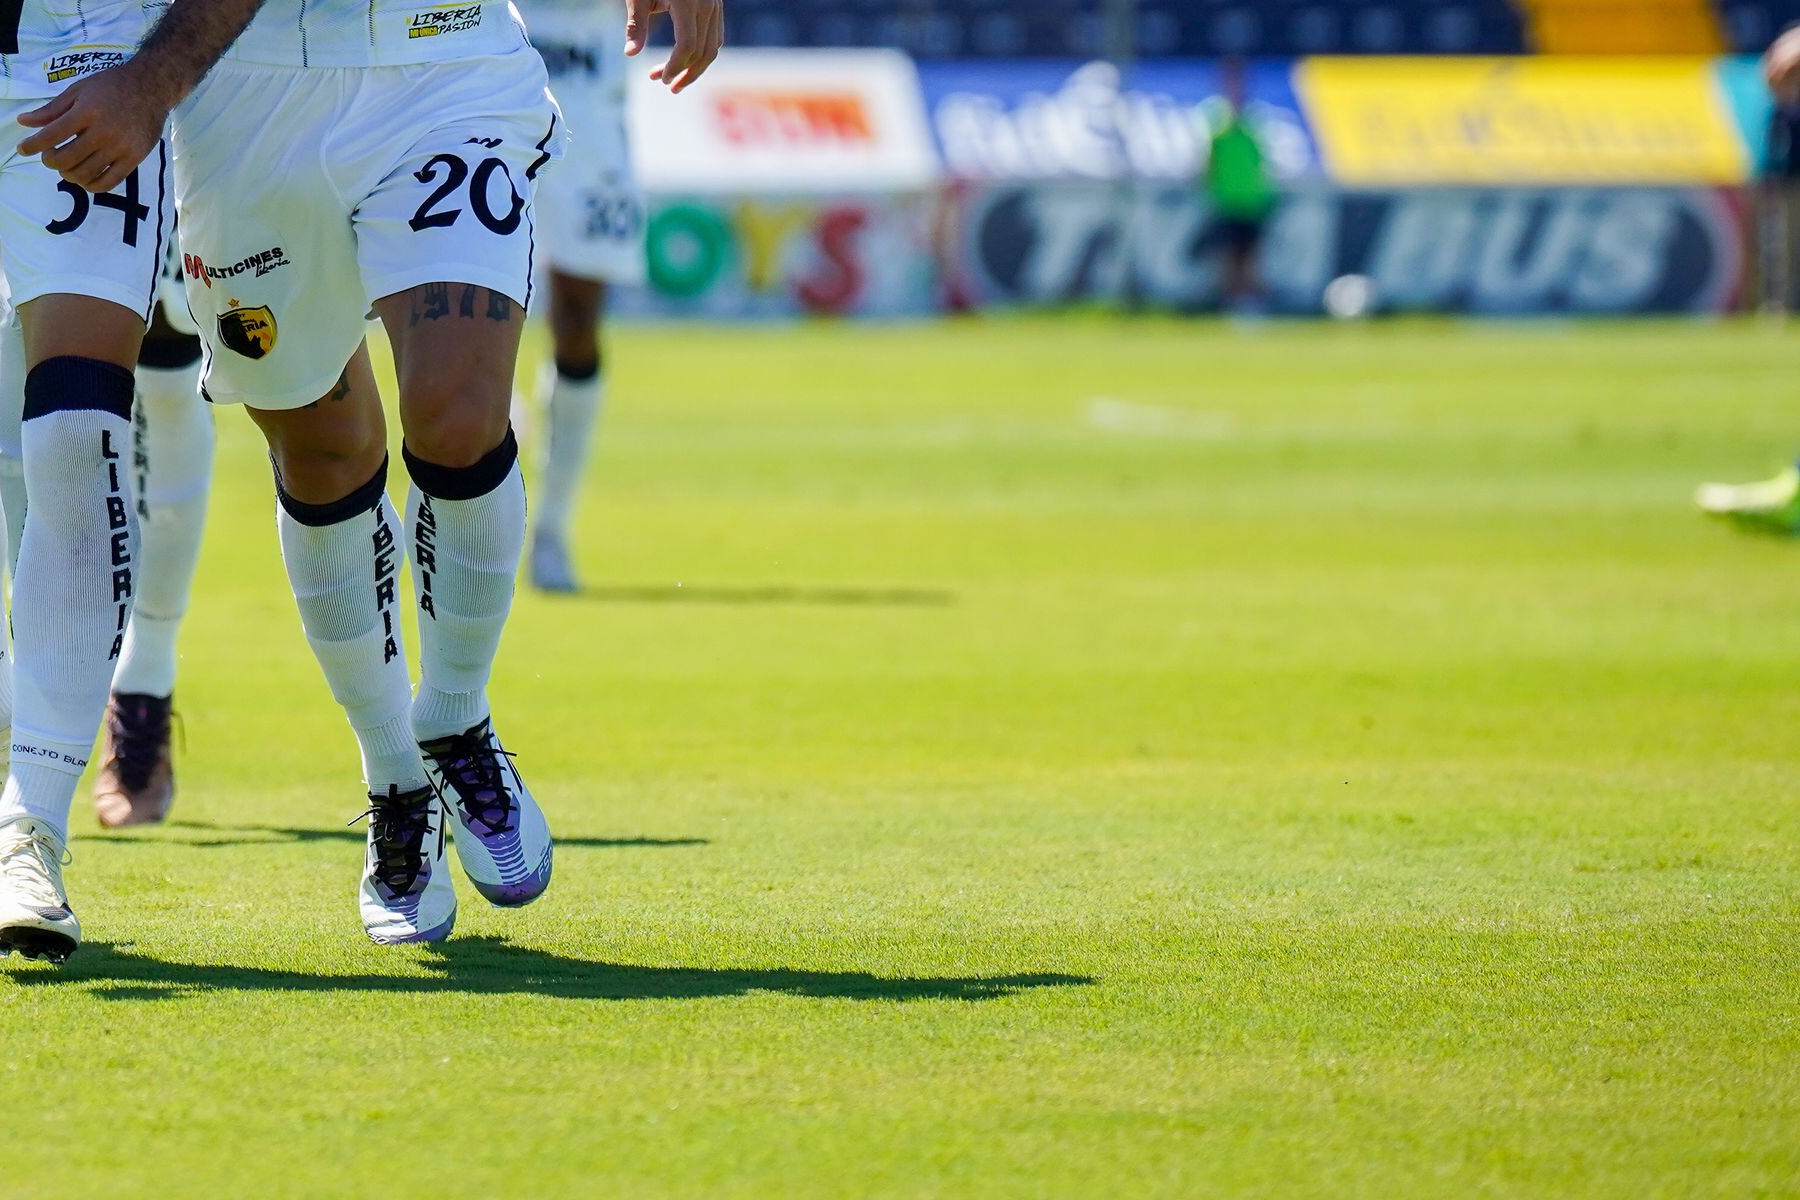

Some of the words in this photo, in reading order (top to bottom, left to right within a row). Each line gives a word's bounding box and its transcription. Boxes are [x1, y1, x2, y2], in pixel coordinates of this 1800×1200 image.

[408, 152, 525, 236] 20
[184, 247, 284, 289] MULTICINES
[101, 429, 132, 661] LIBERIA
